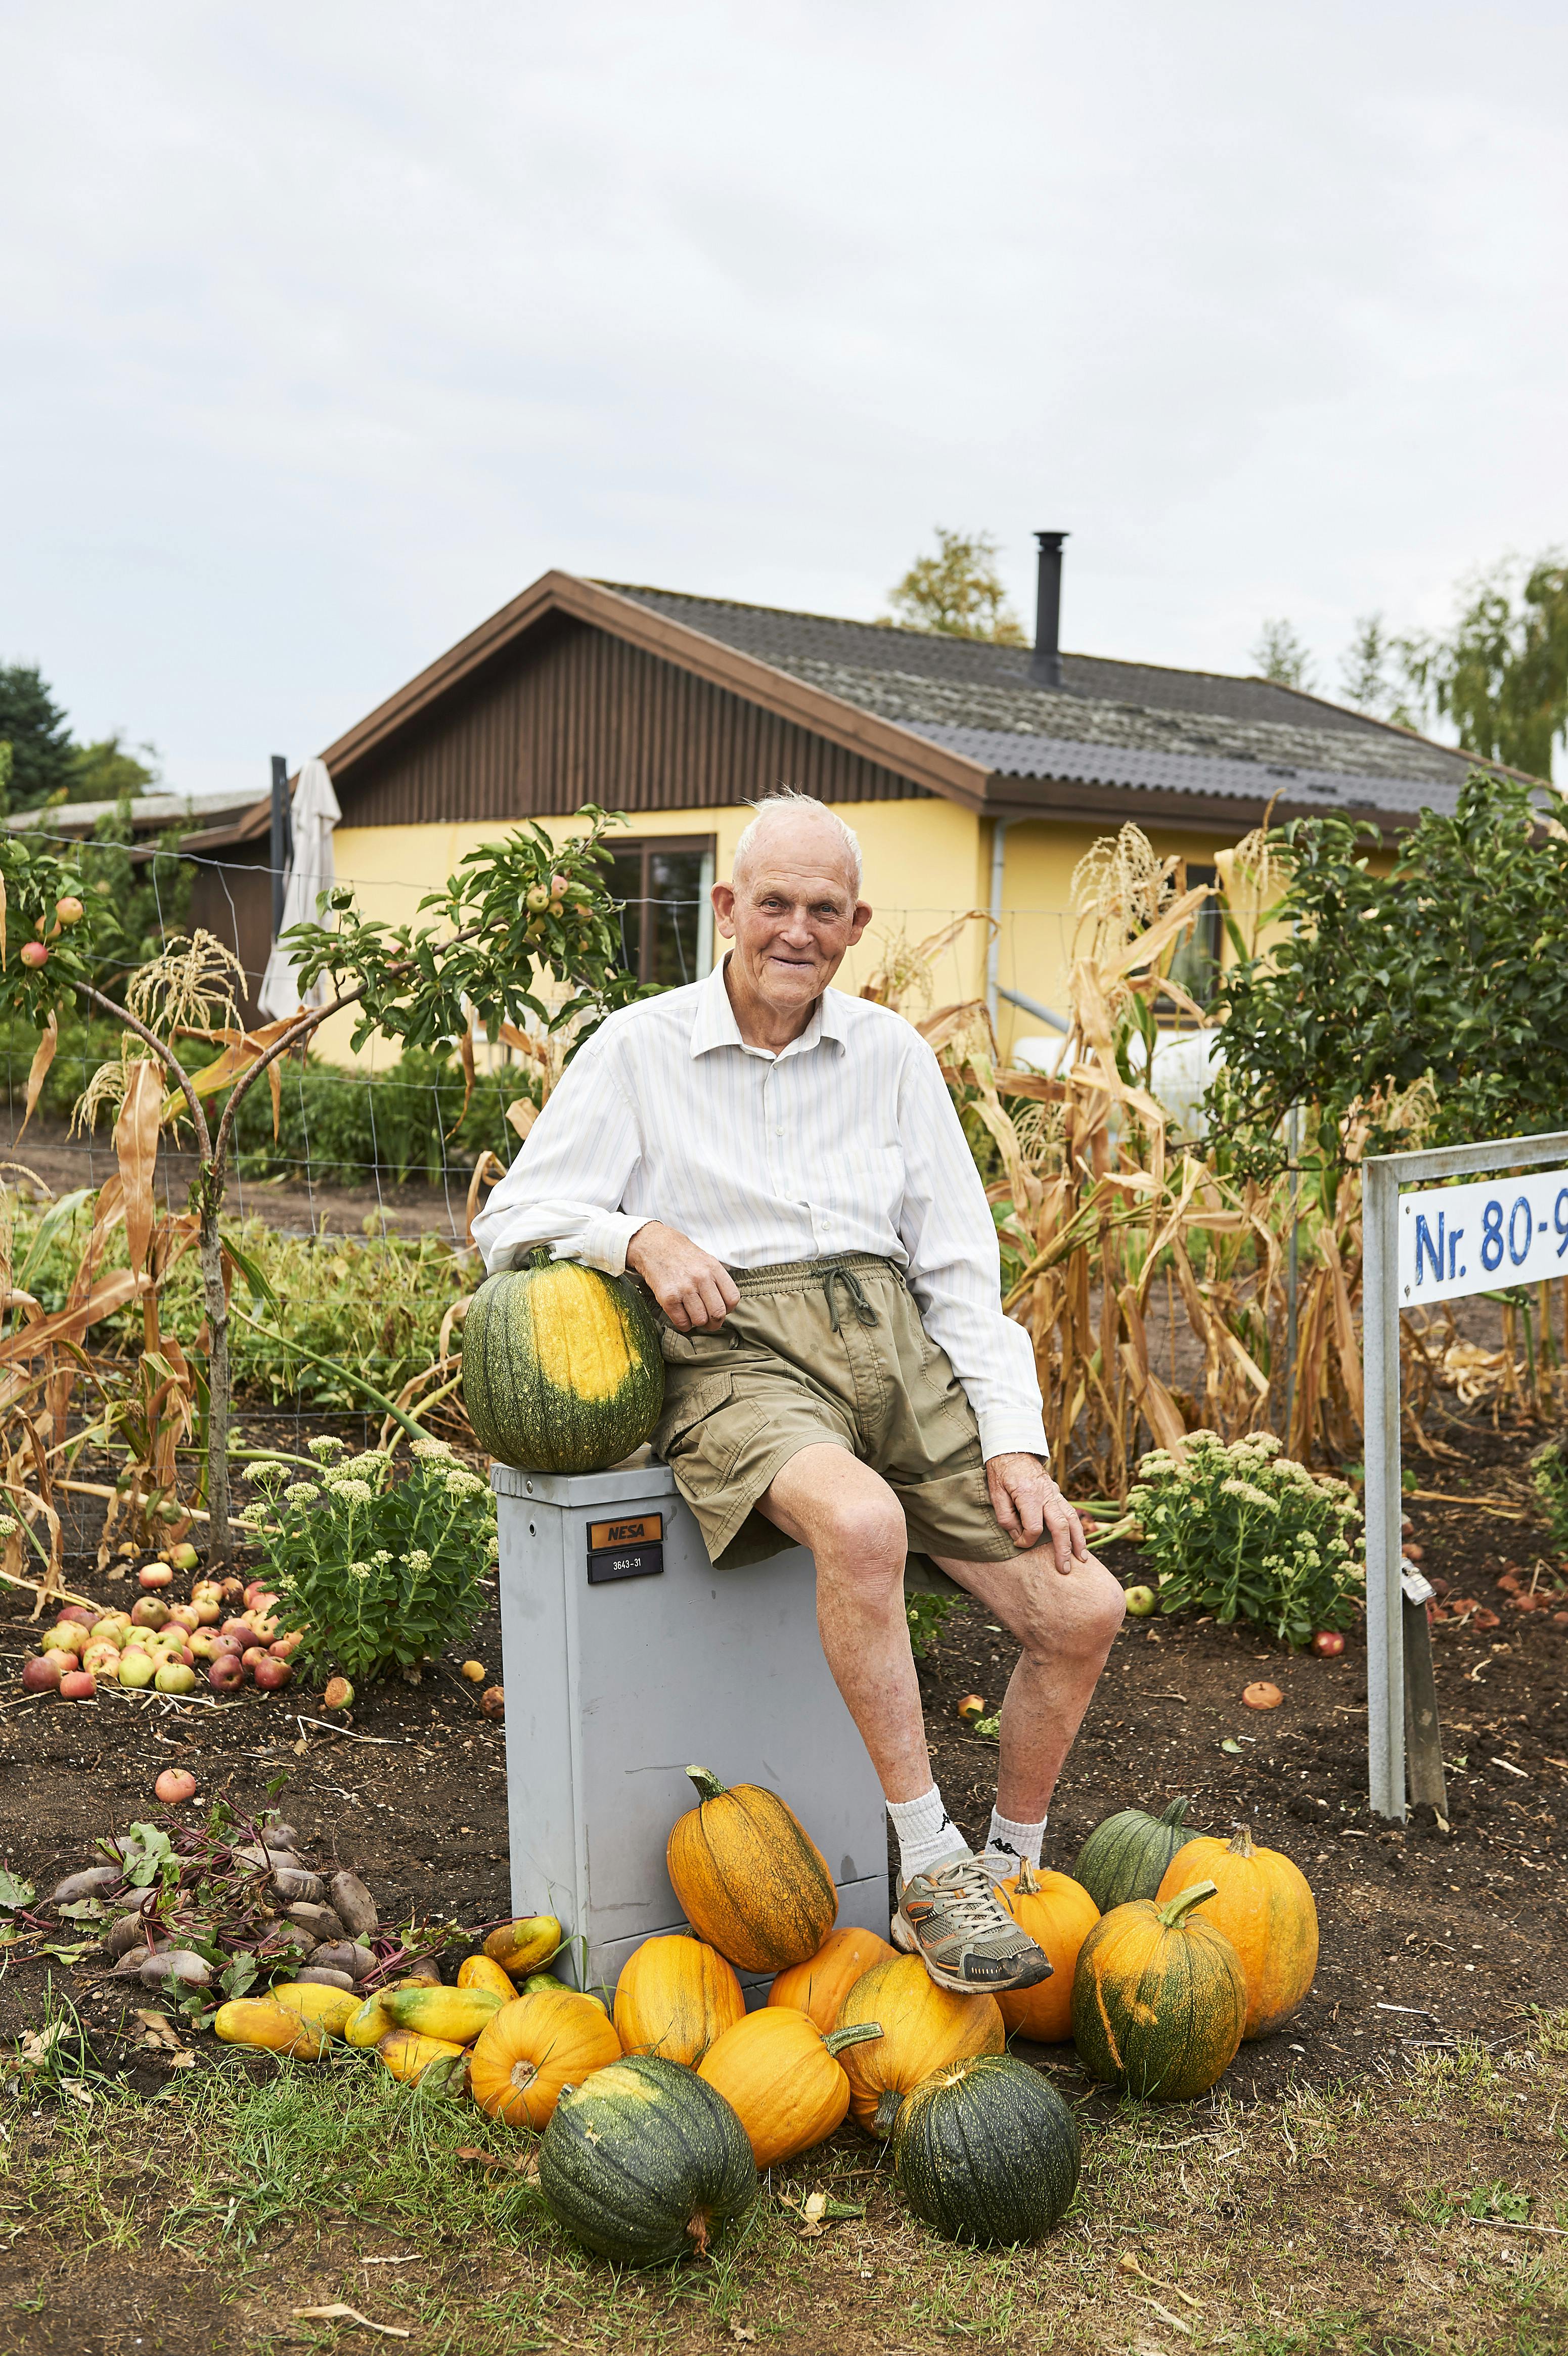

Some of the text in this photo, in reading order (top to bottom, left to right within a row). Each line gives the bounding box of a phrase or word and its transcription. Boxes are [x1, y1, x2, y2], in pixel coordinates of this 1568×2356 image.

[1416, 1211, 1466, 1286] Nr.
[608, 1524, 645, 1541] NESA
[613, 1558, 641, 1570] 3643-31
